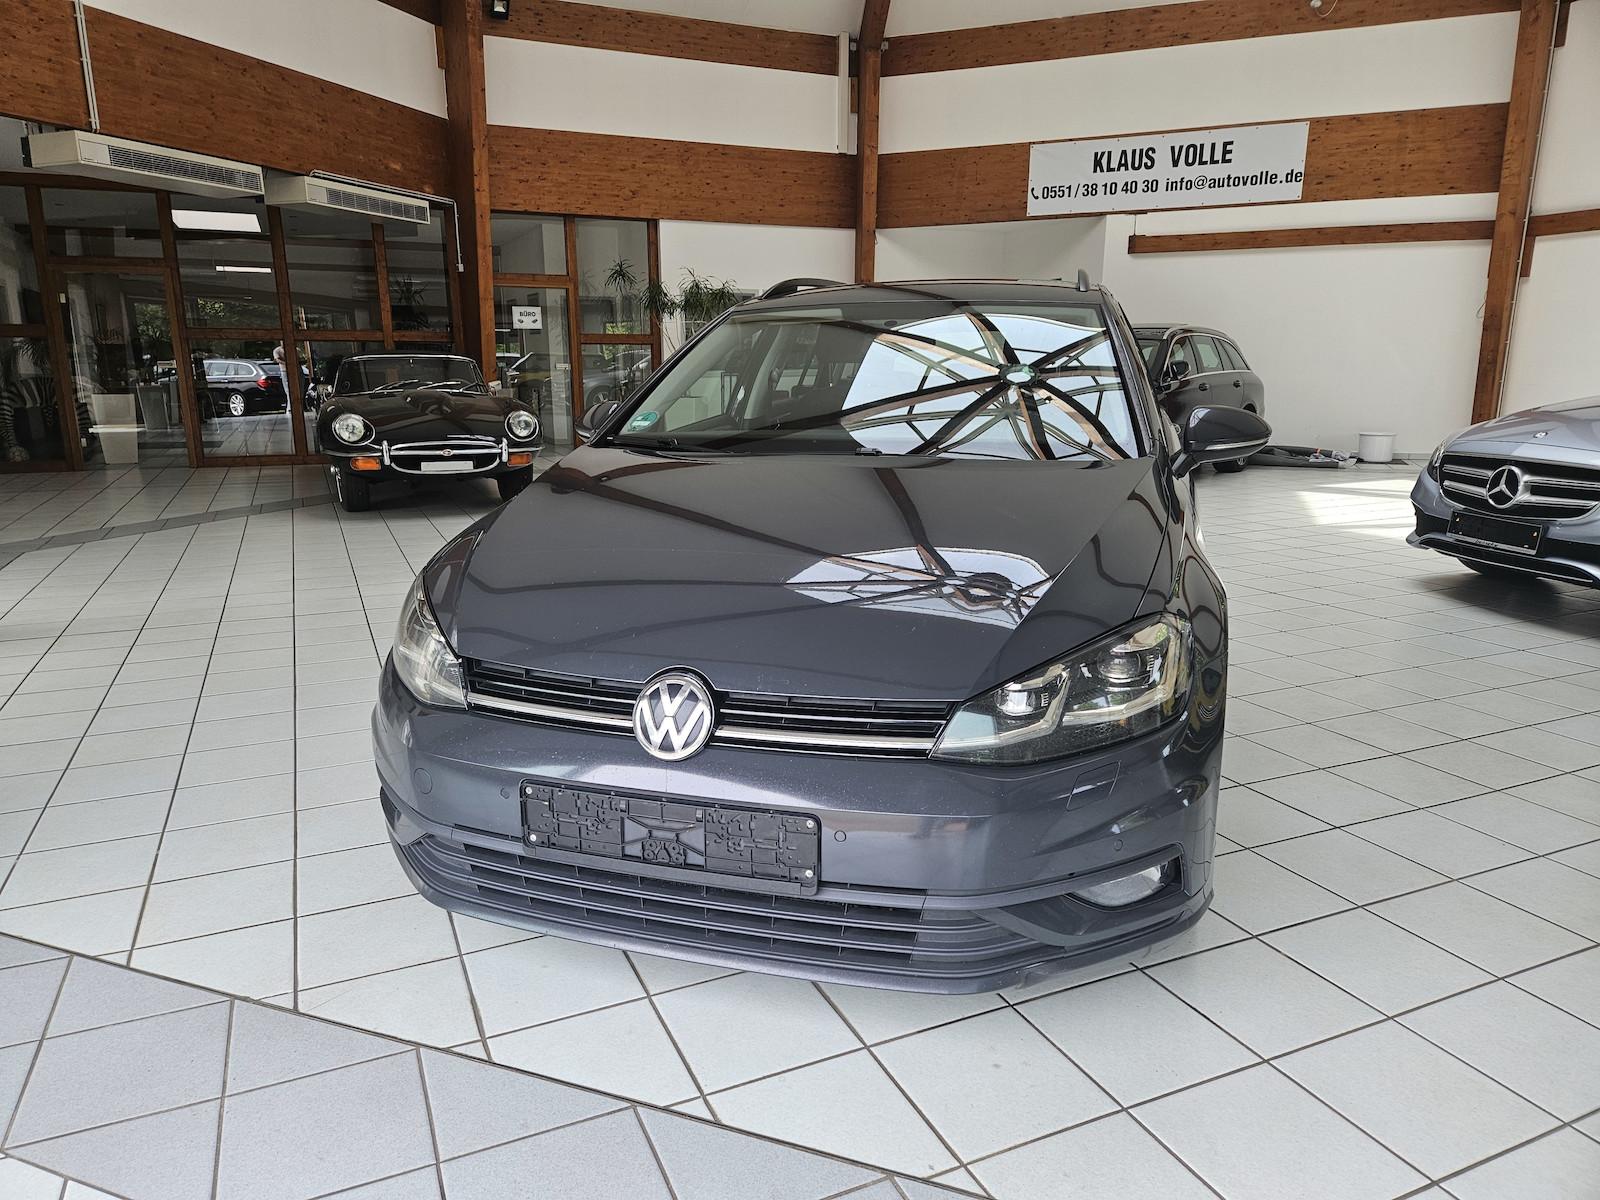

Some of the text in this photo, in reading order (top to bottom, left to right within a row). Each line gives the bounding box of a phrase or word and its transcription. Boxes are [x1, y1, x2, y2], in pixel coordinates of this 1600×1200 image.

[1093, 140, 1235, 173] KLAUS VOLLE
[1101, 181, 1118, 196] 10
[1121, 180, 1138, 194] 40
[1142, 179, 1159, 193] 30
[1165, 169, 1303, 192] info@autovolle.de
[637, 677, 713, 756] VW
